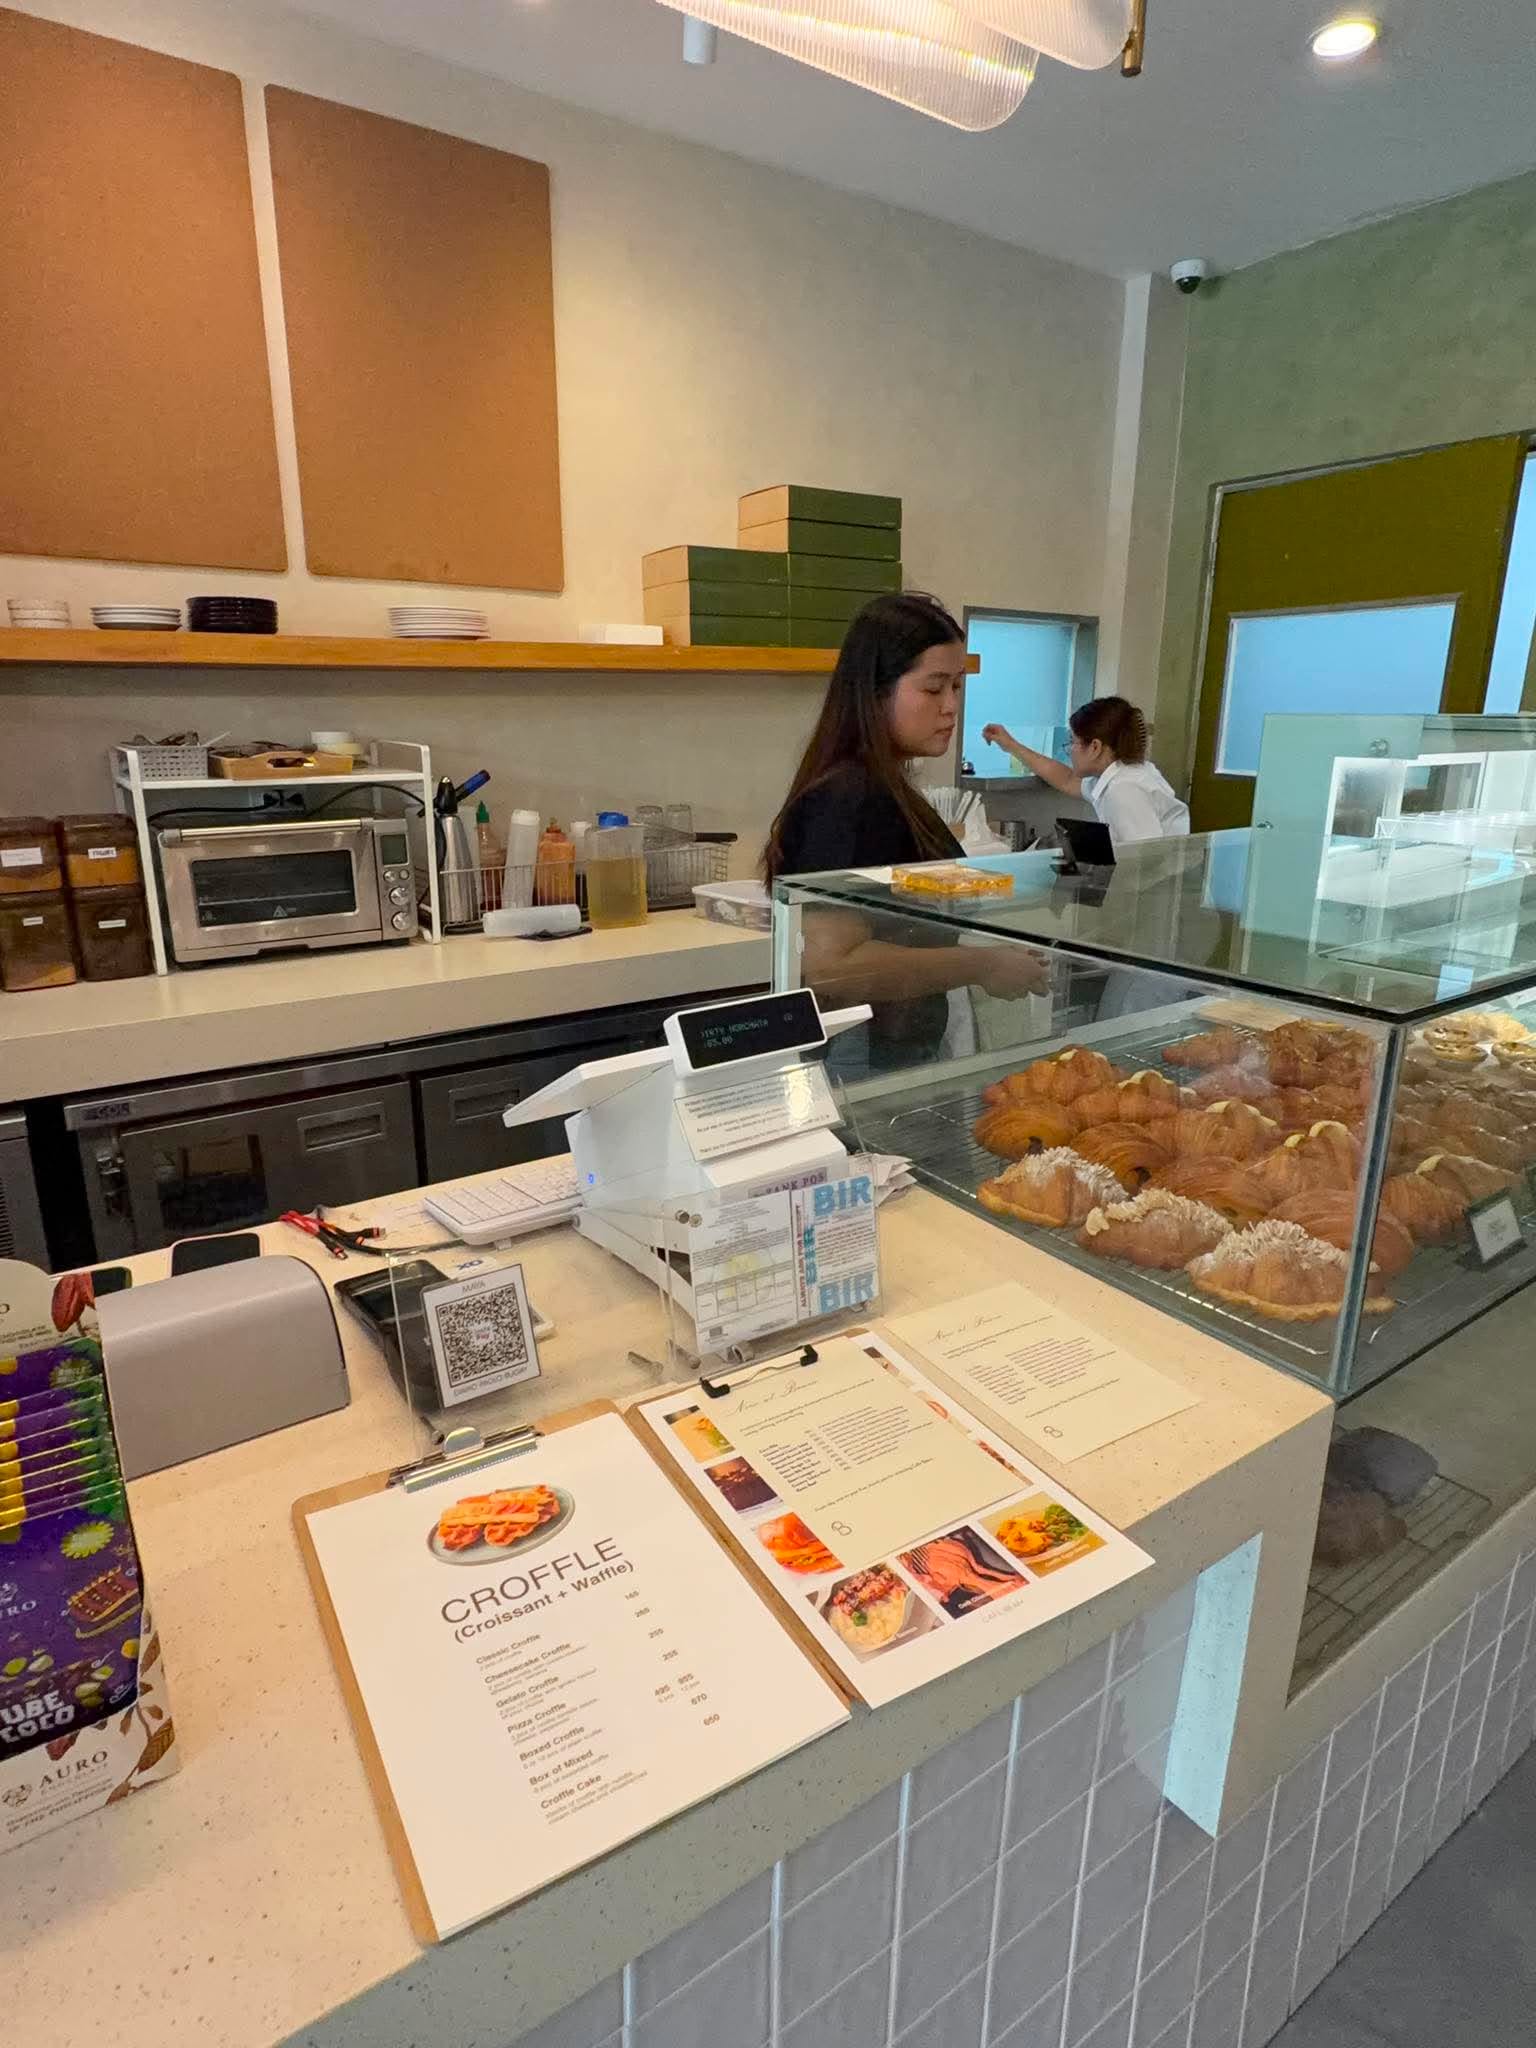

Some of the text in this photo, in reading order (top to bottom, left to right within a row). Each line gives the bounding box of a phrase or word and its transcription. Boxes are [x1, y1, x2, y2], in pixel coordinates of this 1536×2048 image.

[813, 1175, 872, 1217] BIR
[818, 1272, 875, 1312] BIR
[441, 1537, 623, 1624] CROFFLE
[454, 1560, 635, 1644] (Croissant + Waffle)
[476, 1633, 541, 1665] Classic Croffle
[484, 1657, 540, 1684] Cheesecake
[540, 1642, 571, 1660] Croffle
[0, 1690, 65, 1725] UBE
[496, 1676, 560, 1708] Gelato Croffle
[0, 1704, 76, 1744] COCO
[507, 1718, 533, 1734] Pizza
[534, 1703, 567, 1721] Croffle
[519, 1726, 585, 1761] Boxed Croffle
[39, 1750, 108, 1788] AURO
[529, 1750, 593, 1786] Box of Mixed
[540, 1774, 602, 1809] Croffle Cake
